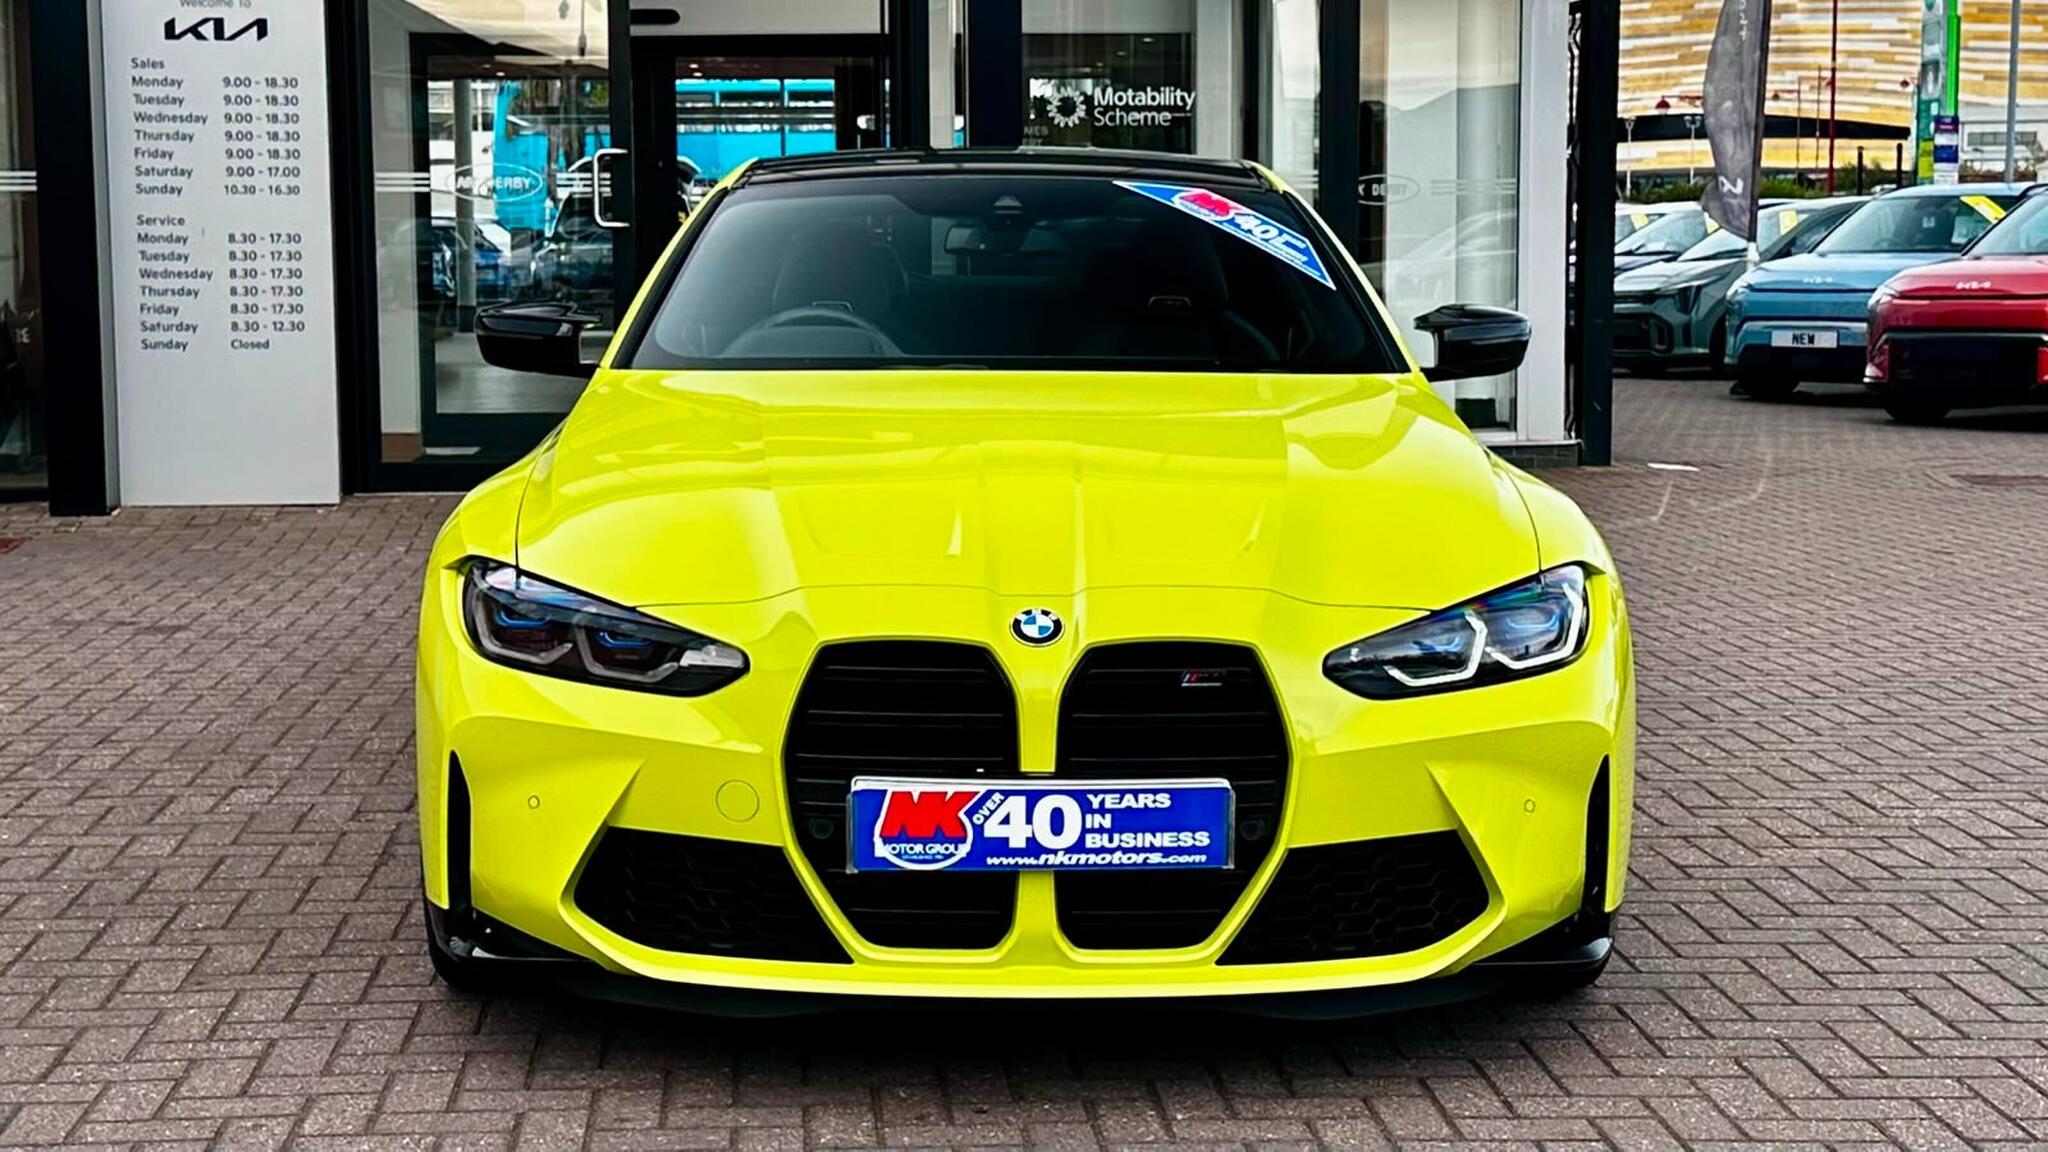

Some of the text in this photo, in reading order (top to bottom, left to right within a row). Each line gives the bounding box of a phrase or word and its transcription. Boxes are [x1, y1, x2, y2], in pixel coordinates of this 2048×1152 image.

[164, 17, 268, 42] KIA
[131, 57, 165, 70] Sales
[132, 76, 184, 90] Monday
[222, 76, 252, 88] 9.00
[264, 77, 298, 89] 18.30
[133, 93, 185, 108] Tuesday
[223, 94, 252, 106] 9.00
[265, 95, 299, 107] 18.30
[1094, 87, 1195, 110] Motability
[134, 112, 208, 126] Wednesday
[224, 112, 253, 124] 9.00
[265, 113, 300, 124] 18.30
[1094, 108, 1172, 126] Scheme
[134, 129, 195, 144] Thursday
[224, 130, 254, 142] 9.00
[266, 131, 300, 142] 18.30
[134, 147, 174, 161] Friday
[225, 148, 254, 160] 9.00
[267, 148, 301, 160] 18.30
[135, 165, 193, 179] Saturday
[225, 166, 255, 178] 9.00
[267, 166, 300, 178] 17.00
[136, 183, 183, 197] Sunday
[224, 184, 256, 195] 10.30
[268, 184, 300, 196] 16.30
[485, 176, 531, 190] ERBY
[137, 214, 185, 226] Service
[137, 232, 189, 246] Monday
[228, 232, 256, 244] 8.30
[269, 232, 302, 244] 17.30
[139, 250, 190, 264] Tuesday
[229, 250, 257, 262] 8.30
[270, 250, 302, 262] 17.30
[139, 268, 213, 282] Wednesday
[229, 268, 258, 279] 8.30
[270, 268, 302, 279] 17.30
[140, 285, 200, 299] Thursday
[230, 285, 258, 297] 8.30
[271, 285, 303, 297] 17.30
[140, 303, 179, 317] Friday
[230, 303, 259, 315] 8.30
[272, 303, 304, 315] 17.30
[140, 320, 198, 334] Saturday
[231, 320, 260, 332] 8.30
[272, 320, 305, 332] 12.30
[141, 338, 270, 352] Sunday Closed
[1792, 332, 1815, 346] NEW
[1086, 793, 1171, 809] YEARS
[880, 791, 980, 838] NK
[972, 792, 1005, 825] OVER
[984, 794, 1082, 849] 40
[1085, 813, 1111, 829] IN
[1085, 831, 1210, 848] BUSINESS
[986, 850, 1206, 866] www.nkmotors.com
